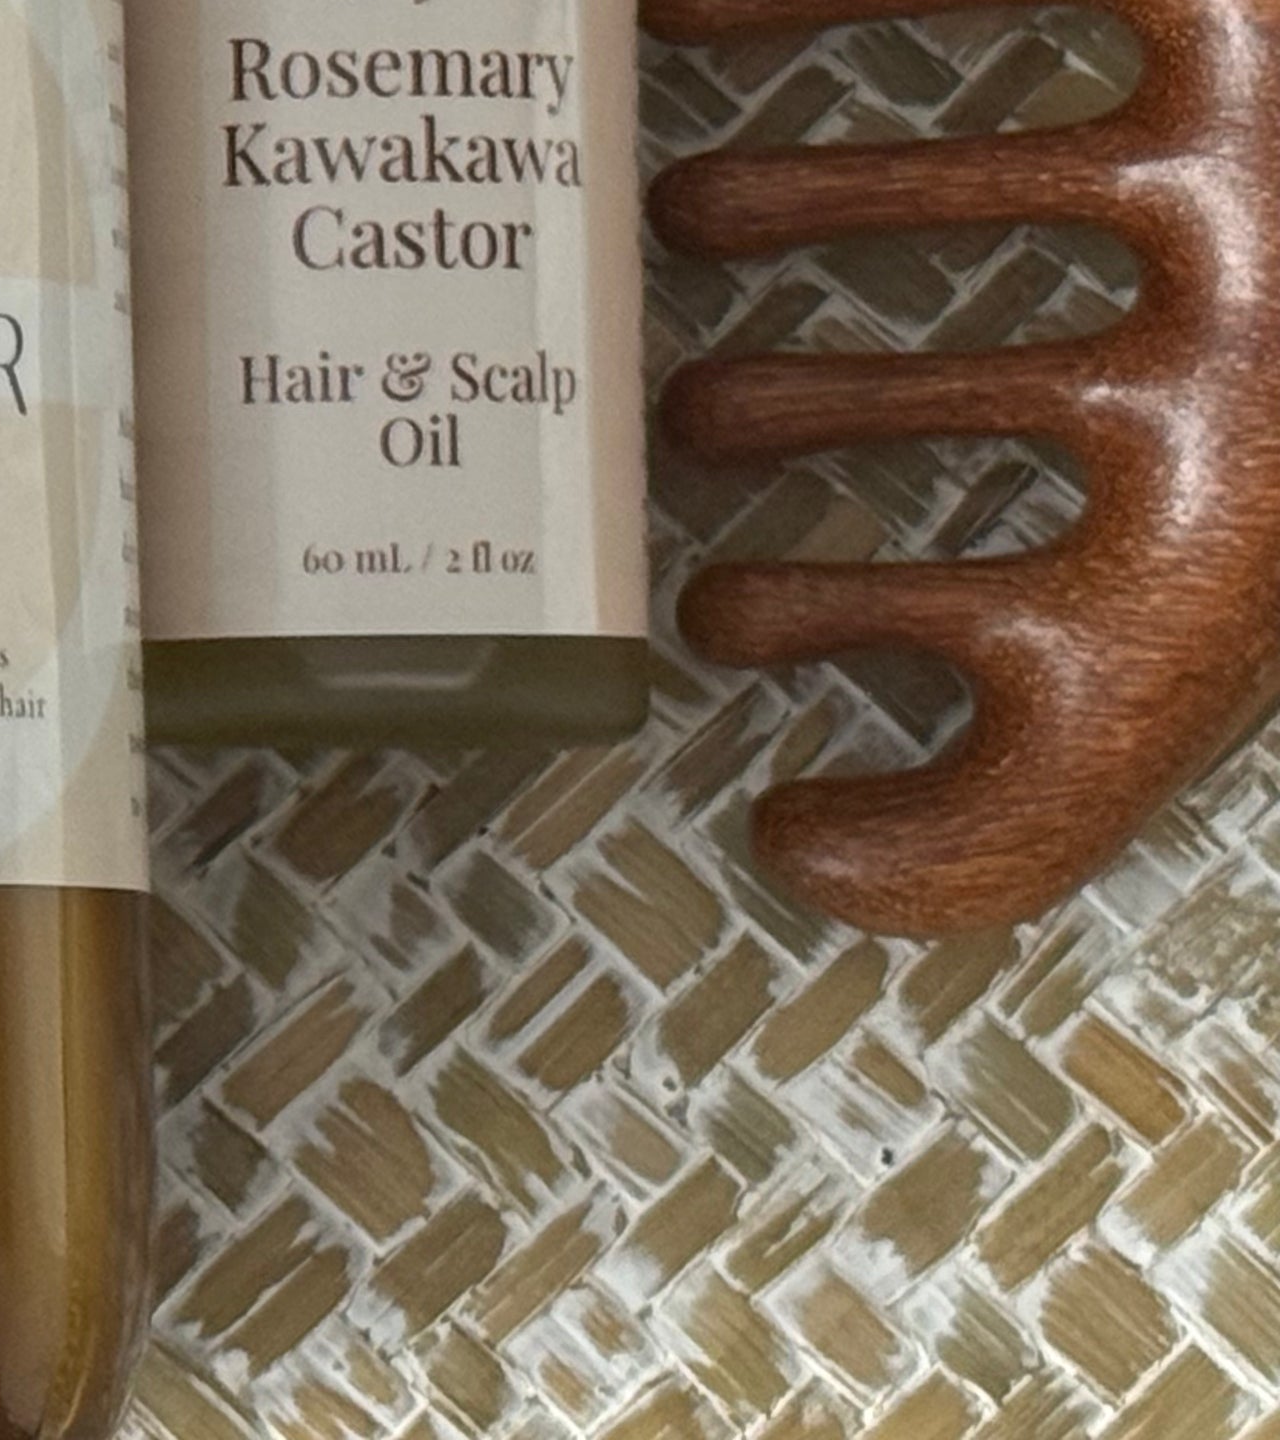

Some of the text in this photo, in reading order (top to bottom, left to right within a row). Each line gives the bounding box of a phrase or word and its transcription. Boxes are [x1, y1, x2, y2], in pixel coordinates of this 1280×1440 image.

[228, 37, 575, 115] Rosemary
[221, 114, 582, 188] Kawakawa
[291, 205, 535, 271] Castor
[239, 349, 577, 414] Hair & Scalp
[379, 412, 462, 468] Oil
[301, 539, 538, 576] 60 mL / 2 fl oz
